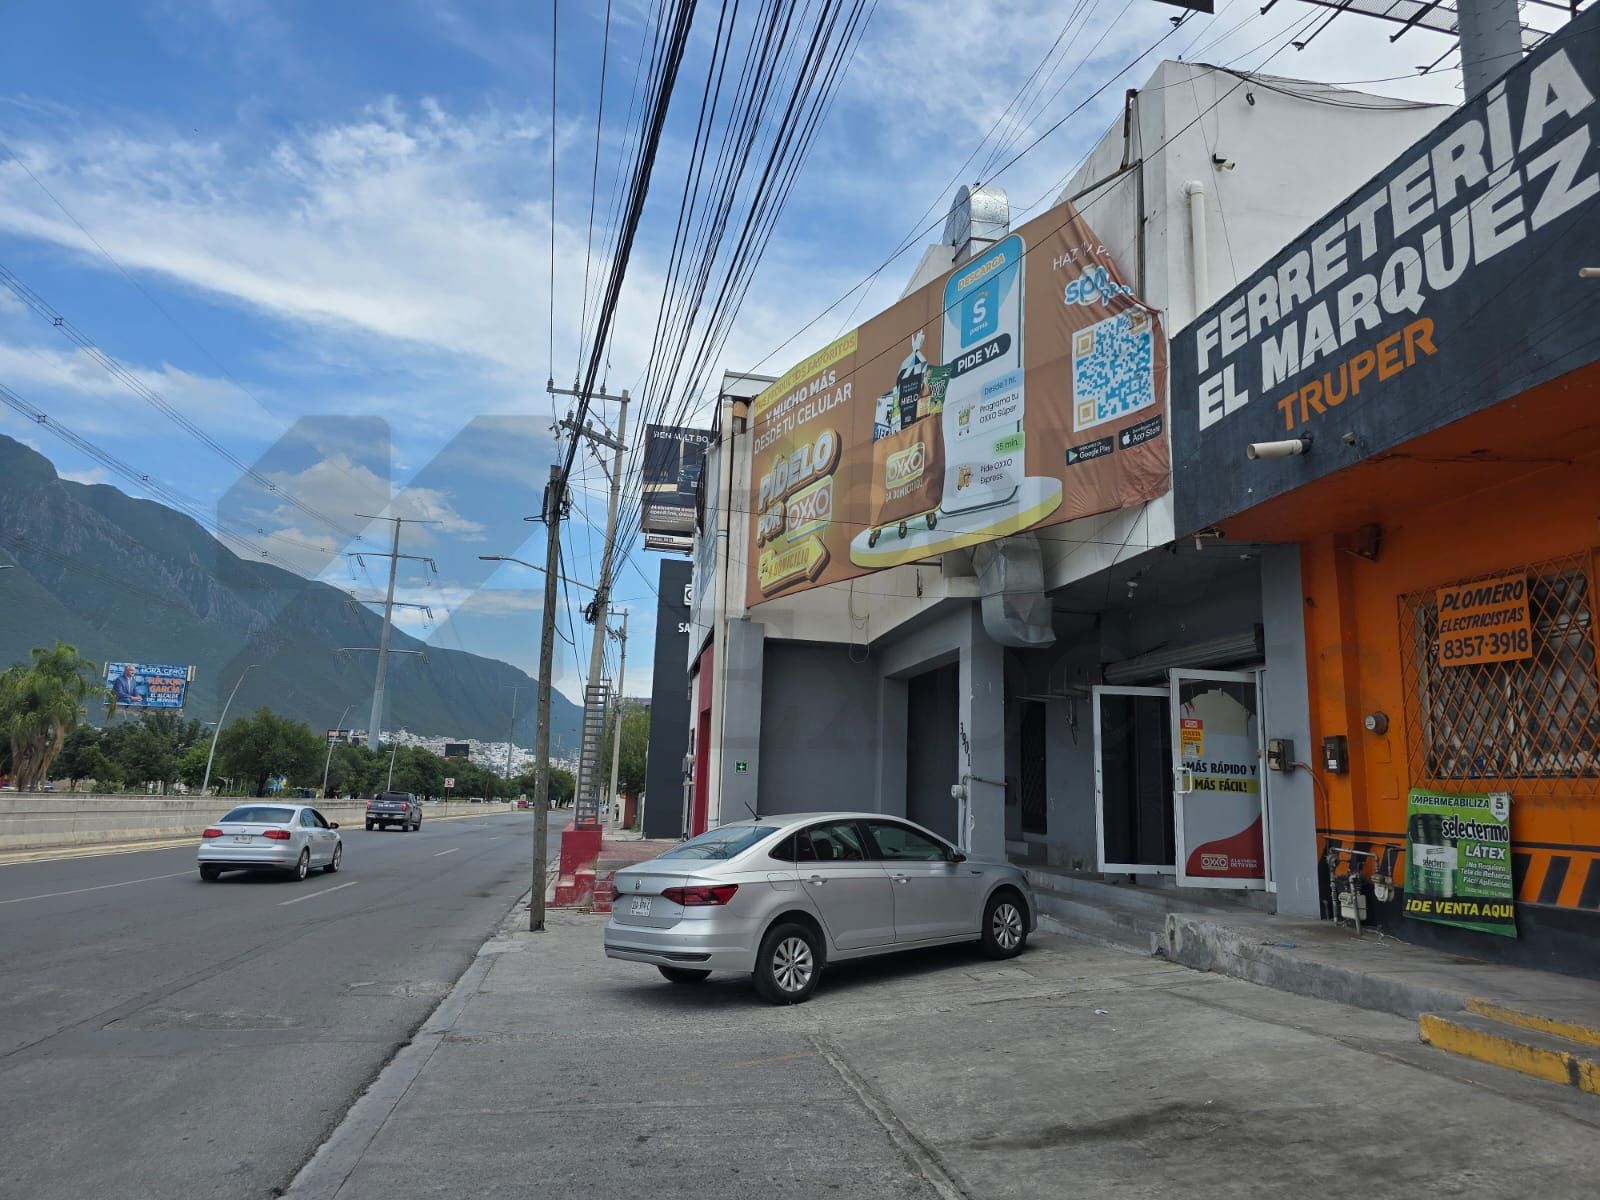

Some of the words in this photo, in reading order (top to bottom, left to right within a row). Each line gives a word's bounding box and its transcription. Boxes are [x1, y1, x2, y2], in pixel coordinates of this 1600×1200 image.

[1053, 247, 1079, 271] HAZ
[957, 253, 1006, 291] DESCARGA
[1199, 364, 1248, 431] EL
[1261, 124, 1600, 393] MARQUEZ
[957, 350, 982, 373] PIDE
[984, 342, 1000, 359] YA
[1277, 317, 1438, 431] TRUPER
[773, 387, 808, 422] MUCHO
[809, 369, 837, 396] MÁS
[979, 396, 1011, 414] Programa
[1012, 393, 1020, 401] tu
[754, 422, 782, 454] DESDE
[782, 413, 795, 434] TU
[797, 382, 853, 425] CELULAR
[979, 411, 997, 424] OXXO
[998, 404, 1017, 418] Súper
[1132, 432, 1144, 443] App
[1145, 425, 1161, 437] Store
[1079, 447, 1099, 459] Google
[1100, 446, 1112, 455] Play
[758, 430, 834, 511] PÍDELO
[887, 450, 922, 480] OXXO
[980, 464, 994, 473] Pide
[994, 458, 1013, 470] OXXO
[980, 472, 1004, 485] Express
[756, 504, 782, 544] POR
[788, 486, 830, 531] OXXO
[1440, 579, 1524, 613] PLOMERO
[1439, 607, 1525, 633] ELECTRICISTAS
[1210, 761, 1247, 775] RÁPIDO
[1250, 765, 1257, 776] Y
[1194, 777, 1216, 791] MÁS
[1219, 778, 1248, 793] FÁCIL!
[1412, 795, 1489, 809] IMPERMEABILIZA
[1495, 797, 1504, 810] 5
[1202, 857, 1227, 867] OXXO
[1465, 843, 1506, 860] LÁTEX
[1405, 899, 1432, 913] ¡DE
[1435, 901, 1479, 916] VENTA
